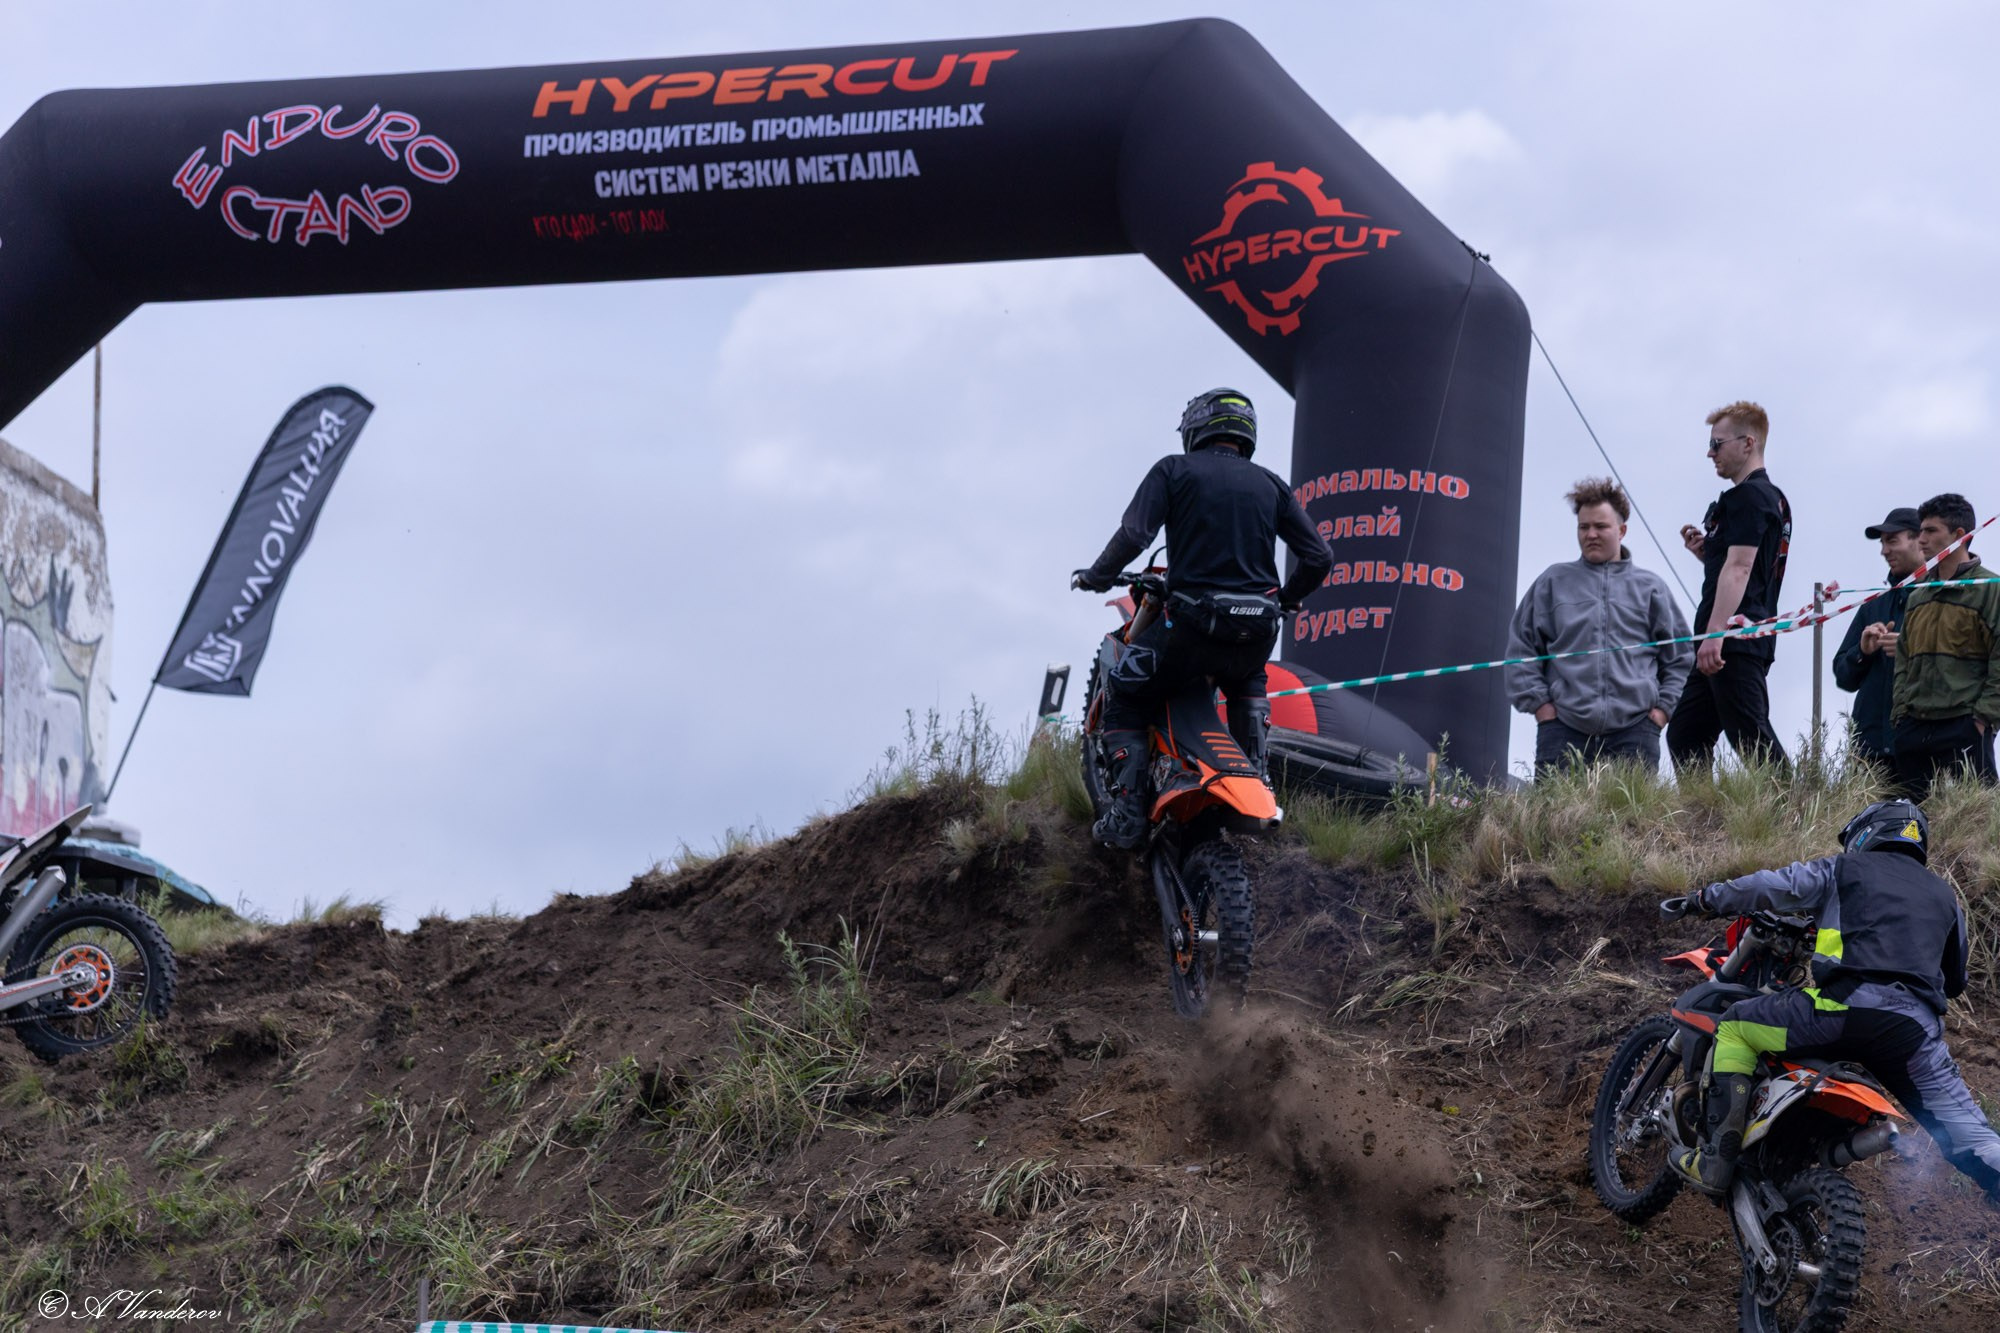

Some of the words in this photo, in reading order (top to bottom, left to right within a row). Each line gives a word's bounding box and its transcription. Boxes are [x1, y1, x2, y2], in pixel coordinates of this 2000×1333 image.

[532, 49, 1019, 117] HYPERCUT
[523, 121, 746, 158] ПРОИЗВОДИТЕЛЬ
[752, 102, 986, 142] ПРОМЫШЛЕННЫХ
[172, 103, 460, 209] ENDURO
[594, 163, 699, 199] СИСТЕМ
[703, 156, 791, 191] РЕЗКИ
[795, 149, 921, 184] МЕТАЛЛА
[532, 215, 561, 239] КТО
[610, 210, 638, 235] ТОТ
[1182, 226, 1402, 284] HYPERCUT
[1316, 506, 1401, 542] елай
[1322, 560, 1464, 592] ально
[1229, 606, 1264, 616] USWE
[1294, 607, 1393, 643] будет
